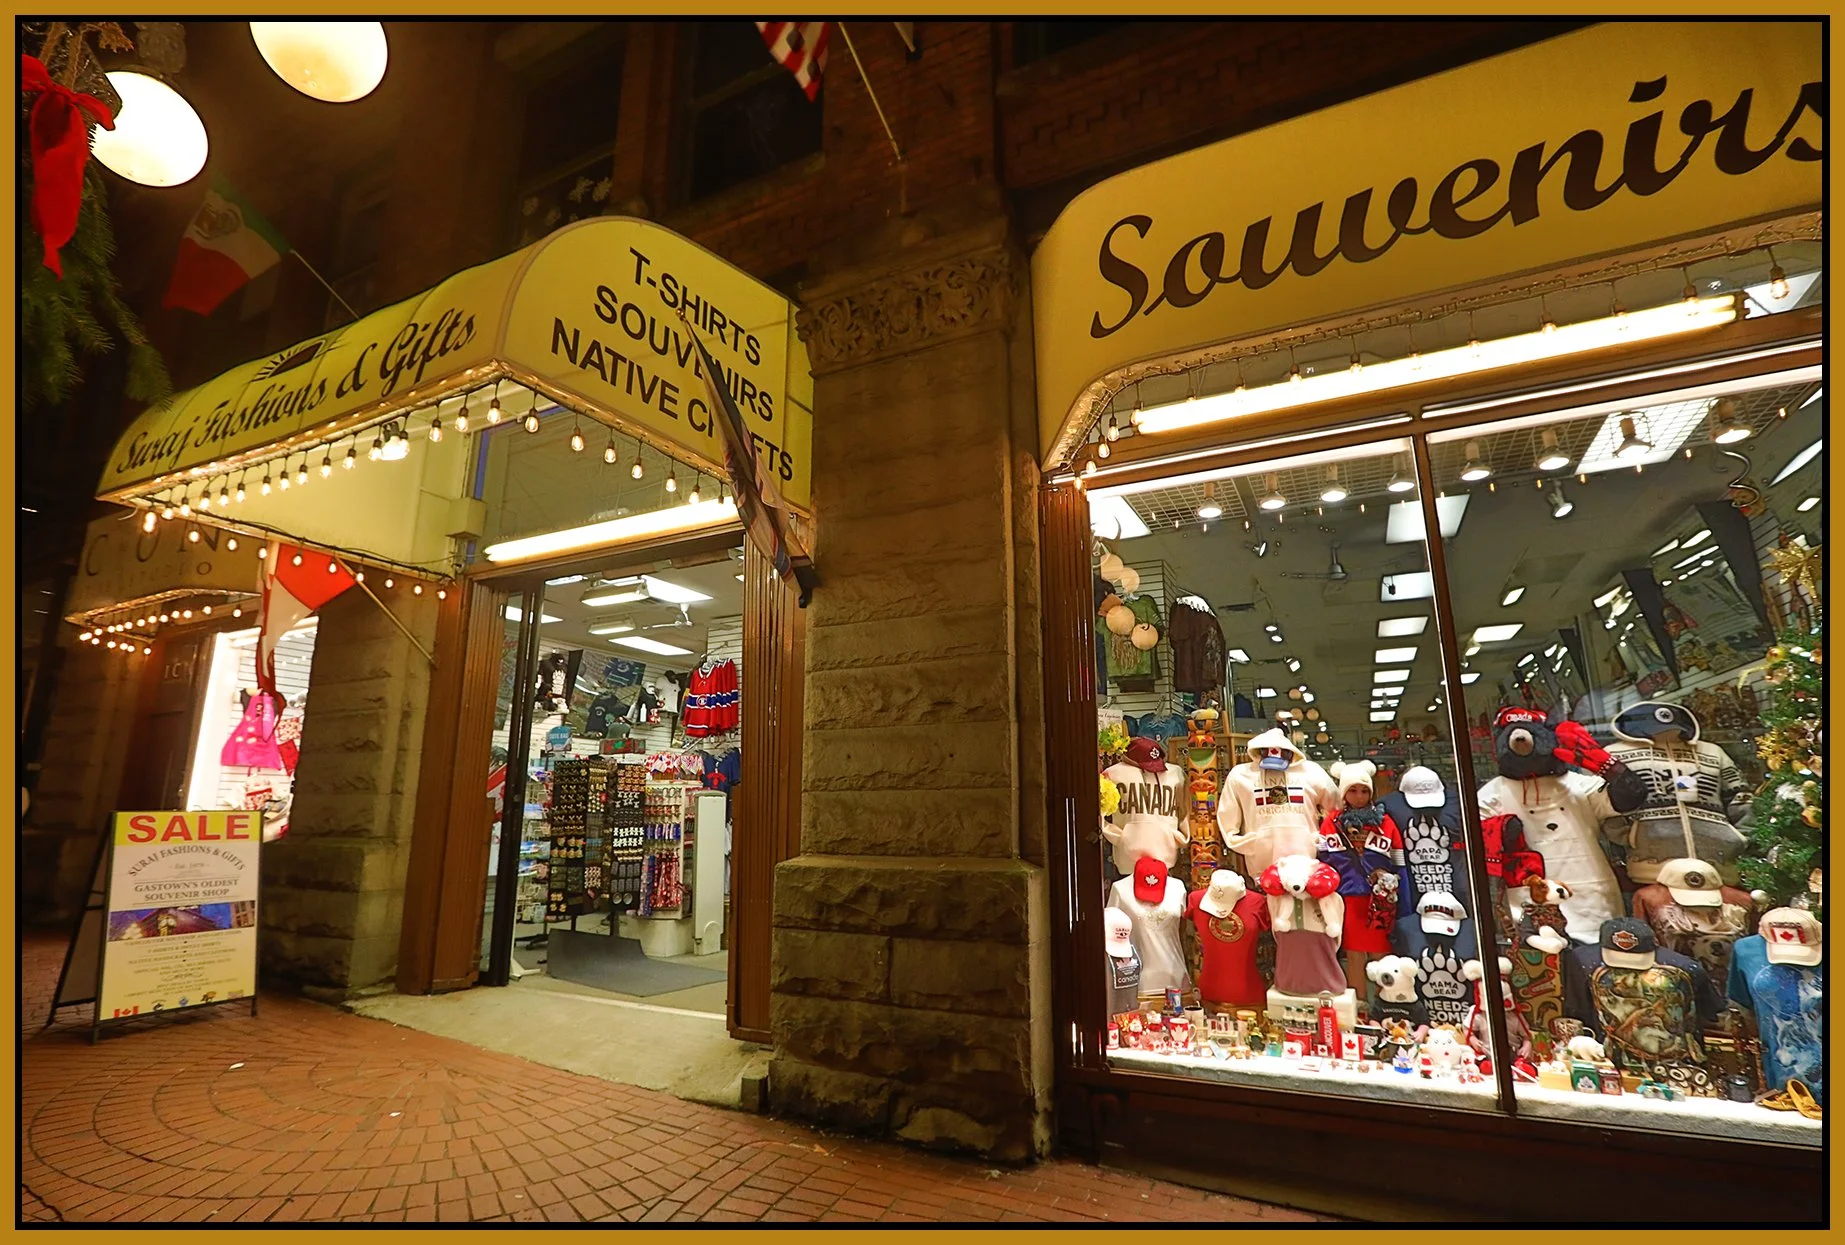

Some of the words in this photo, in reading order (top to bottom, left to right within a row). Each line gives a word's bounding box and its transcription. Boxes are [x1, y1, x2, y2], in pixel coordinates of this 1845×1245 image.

[1090, 75, 1822, 339] Souvenirs
[629, 246, 761, 367] T-SHIRTS
[116, 412, 200, 474] Suraj
[194, 379, 328, 449] Fashions
[379, 307, 478, 397] Gifts
[551, 317, 680, 420] NATIVE
[687, 397, 793, 481] CFTS
[1116, 782, 1180, 817] CANADA
[127, 814, 250, 843] SALE
[128, 853, 159, 877] SURAJ
[160, 845, 211, 859] FASHIONS
[212, 848, 220, 856] &
[221, 850, 246, 871] GIFTS
[1411, 864, 1453, 875] NEEDS
[1414, 874, 1453, 884] SOME
[134, 882, 198, 892] GASTOWN'S
[1417, 883, 1453, 893] BEER
[144, 890, 200, 901] SOUVENIR
[202, 888, 230, 897] SHOP
[1424, 904, 1454, 918] CANADA
[1429, 980, 1458, 989] MAMA
[1433, 988, 1457, 996] BEAR
[1424, 1000, 1470, 1011] NEEDS
